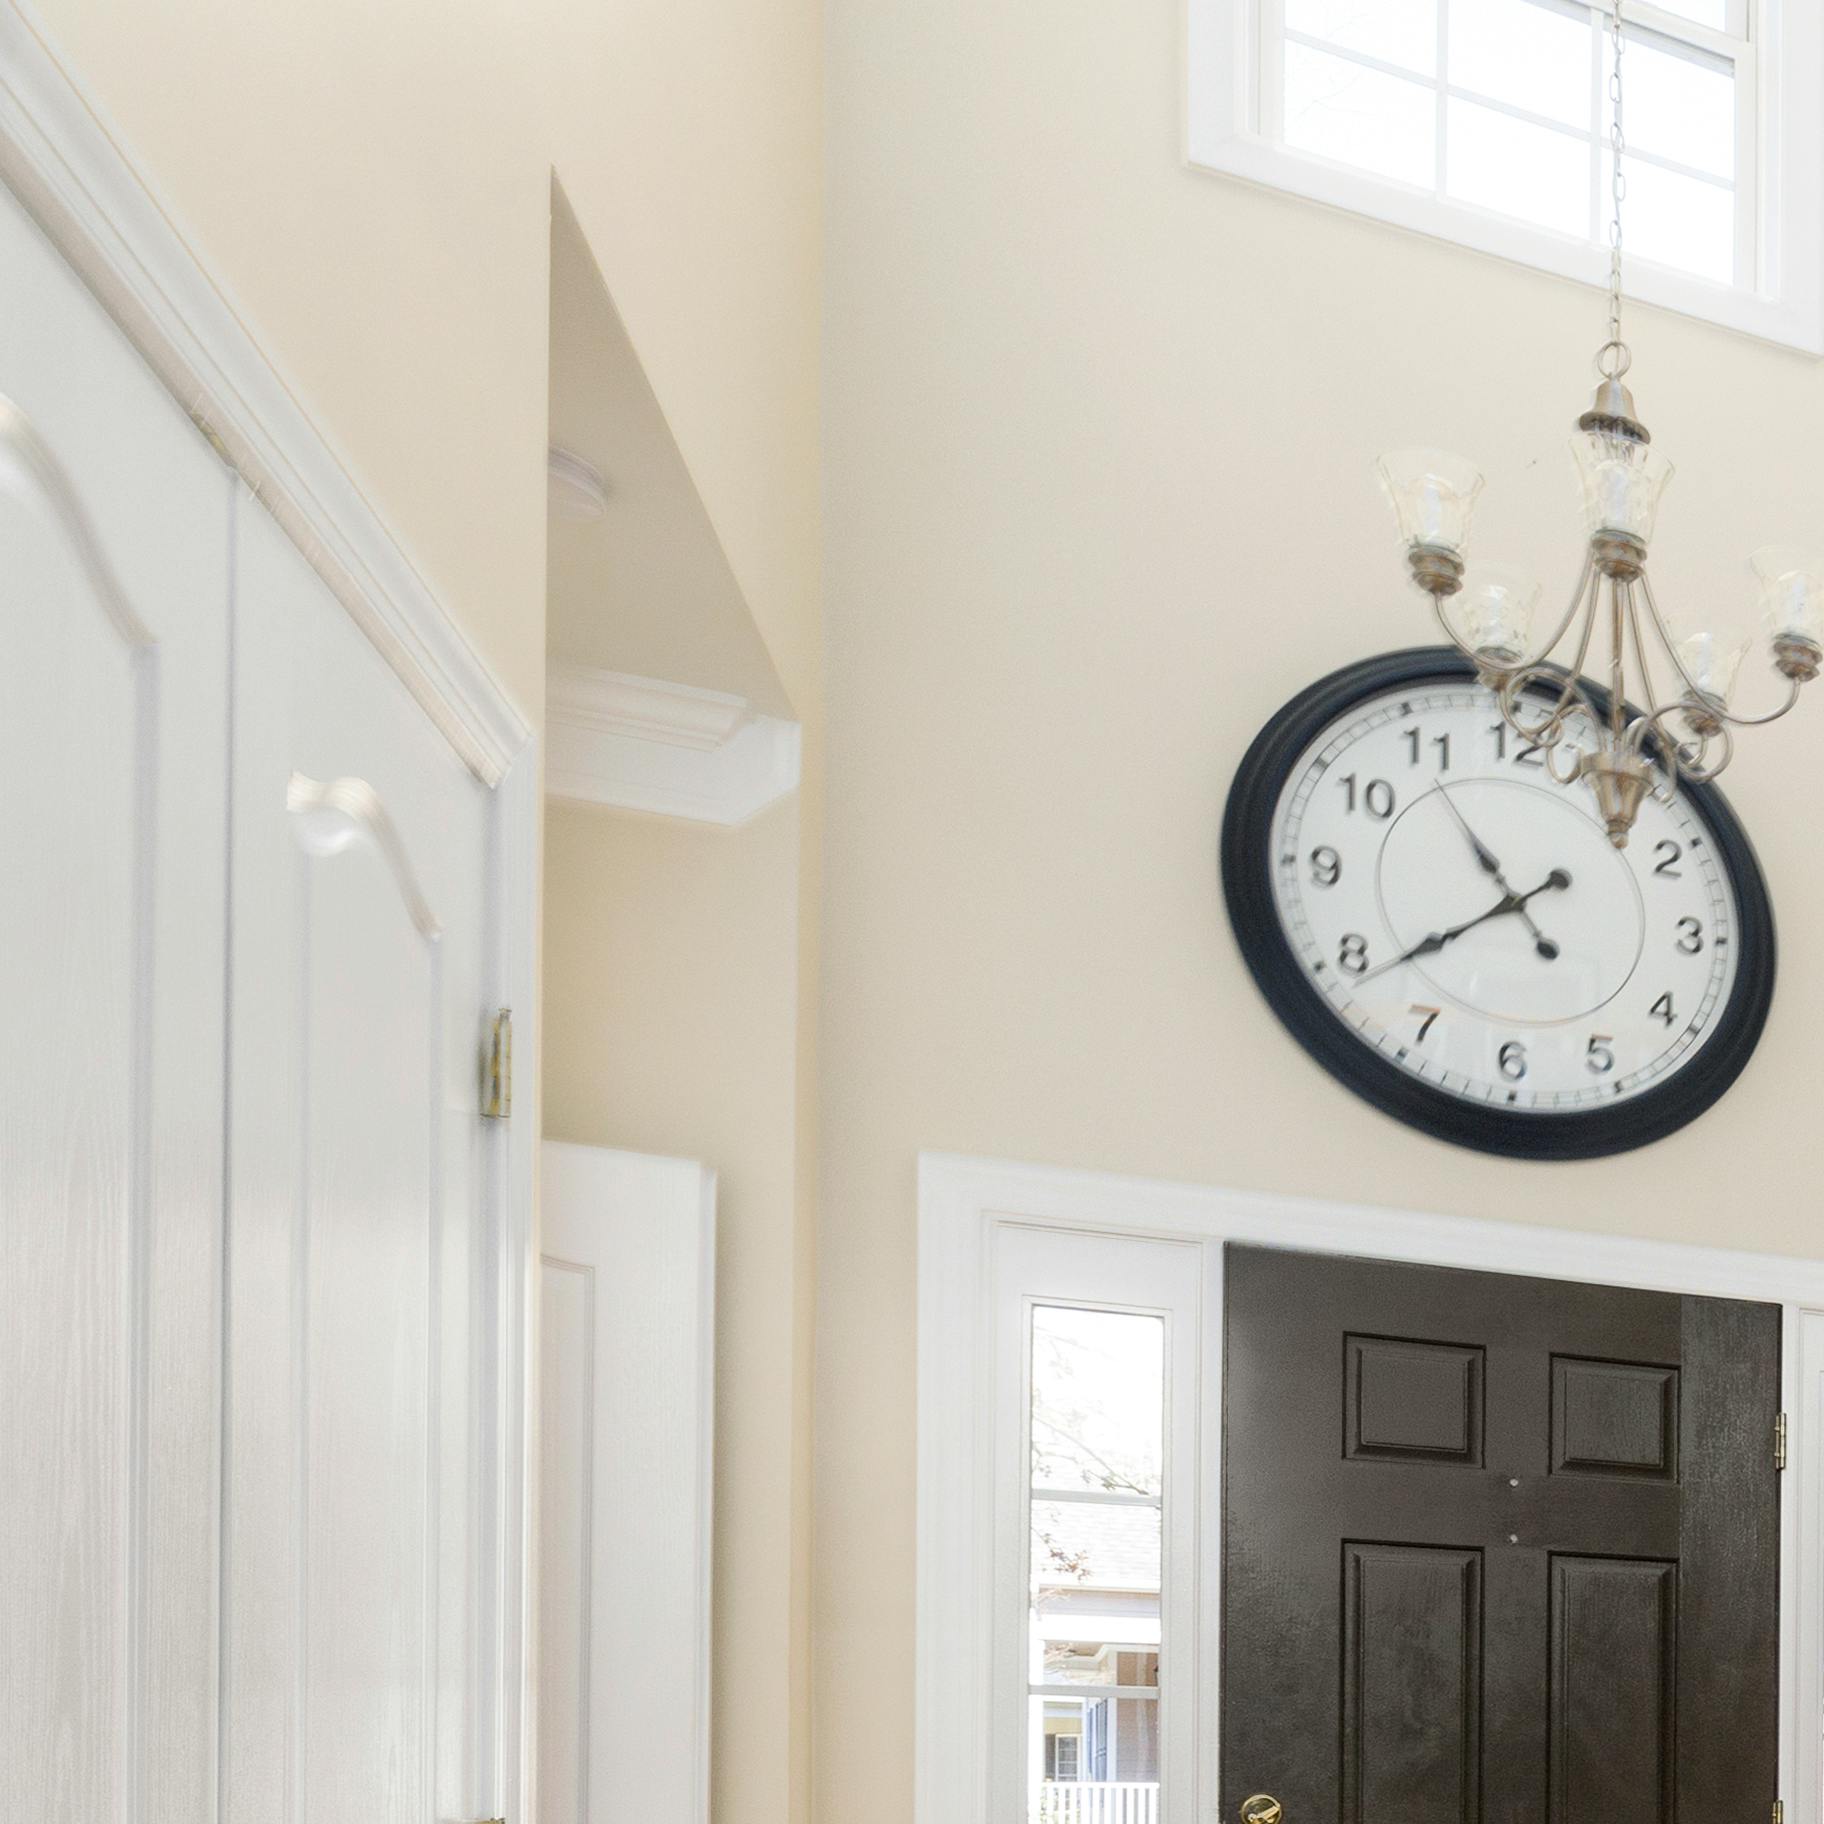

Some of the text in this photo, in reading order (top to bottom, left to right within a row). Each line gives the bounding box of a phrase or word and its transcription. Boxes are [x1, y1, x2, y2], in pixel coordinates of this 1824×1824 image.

[1403, 725, 1451, 771] 11
[1339, 773, 1394, 818] 10
[1309, 846, 1342, 888] 9
[1654, 840, 1682, 879] 2
[1337, 933, 1369, 976] 8
[1674, 916, 1704, 956] 3
[1408, 1004, 1441, 1043] 7
[1650, 991, 1678, 1027] 4
[1499, 1041, 1528, 1081] 6
[1586, 1035, 1615, 1074] 5
